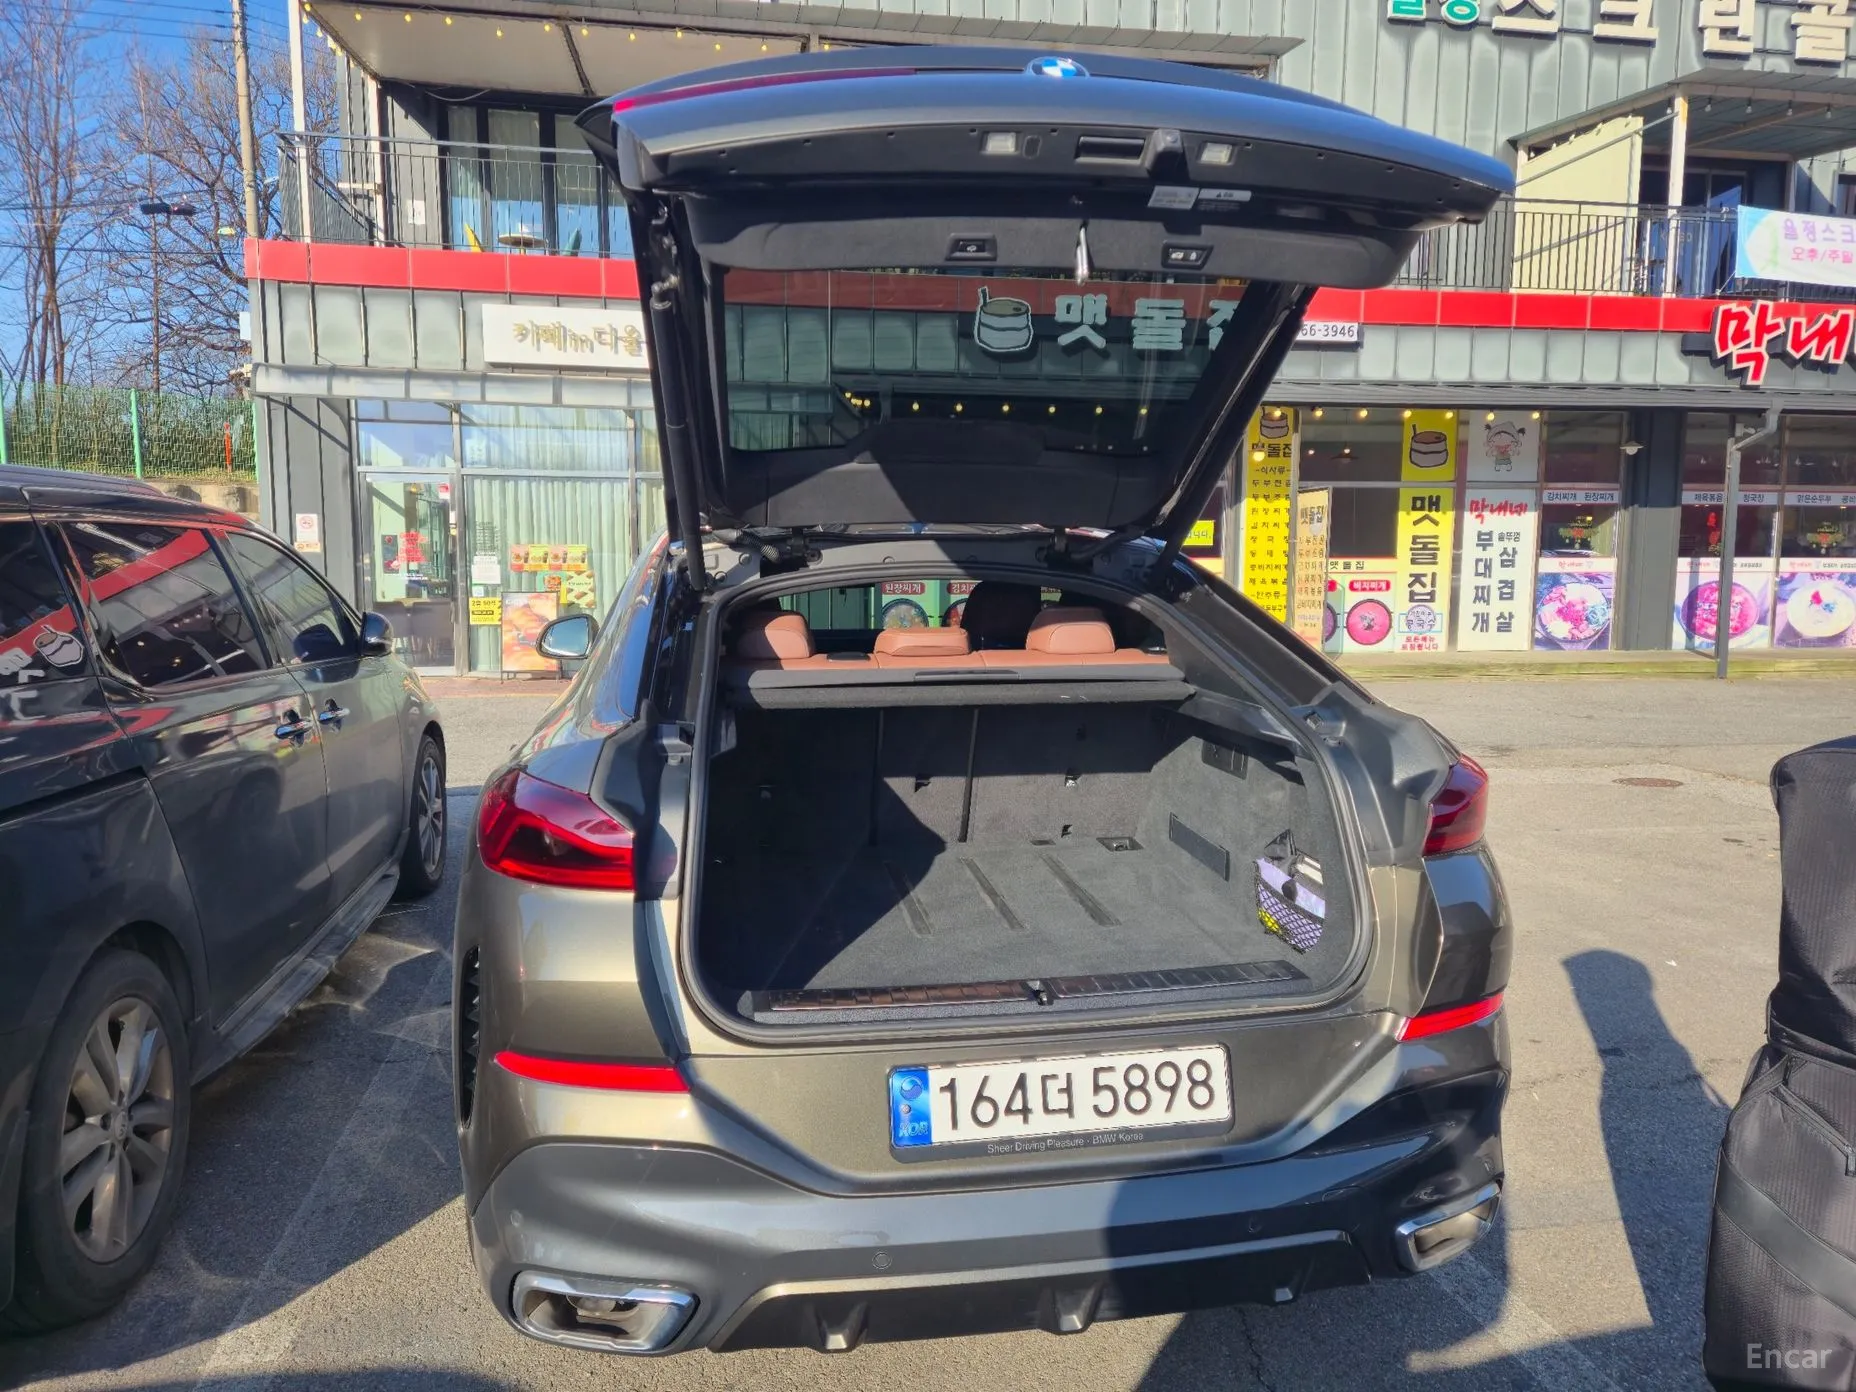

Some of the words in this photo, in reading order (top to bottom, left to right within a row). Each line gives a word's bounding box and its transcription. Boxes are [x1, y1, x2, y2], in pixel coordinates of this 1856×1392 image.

[1714, 299, 1856, 386] 막내
[1469, 497, 1529, 525] 막내네
[1547, 492, 1577, 502] 김치찌개
[1584, 492, 1614, 502] 된장찌개
[1408, 494, 1441, 603] 맷돌집
[1471, 530, 1494, 633] 부대찌개
[885, 583, 921, 594] 된장찌개
[1495, 546, 1518, 633] 삼겹살
[939, 1072, 1074, 1131] 164더
[1092, 1058, 1216, 1119] 5898
[987, 1143, 1013, 1154] Sheer
[1015, 1140, 1046, 1152] Driving
[1047, 1137, 1084, 1149] Pleasure
[1092, 1134, 1116, 1145] BMW
[1119, 1132, 1144, 1142] Korea
